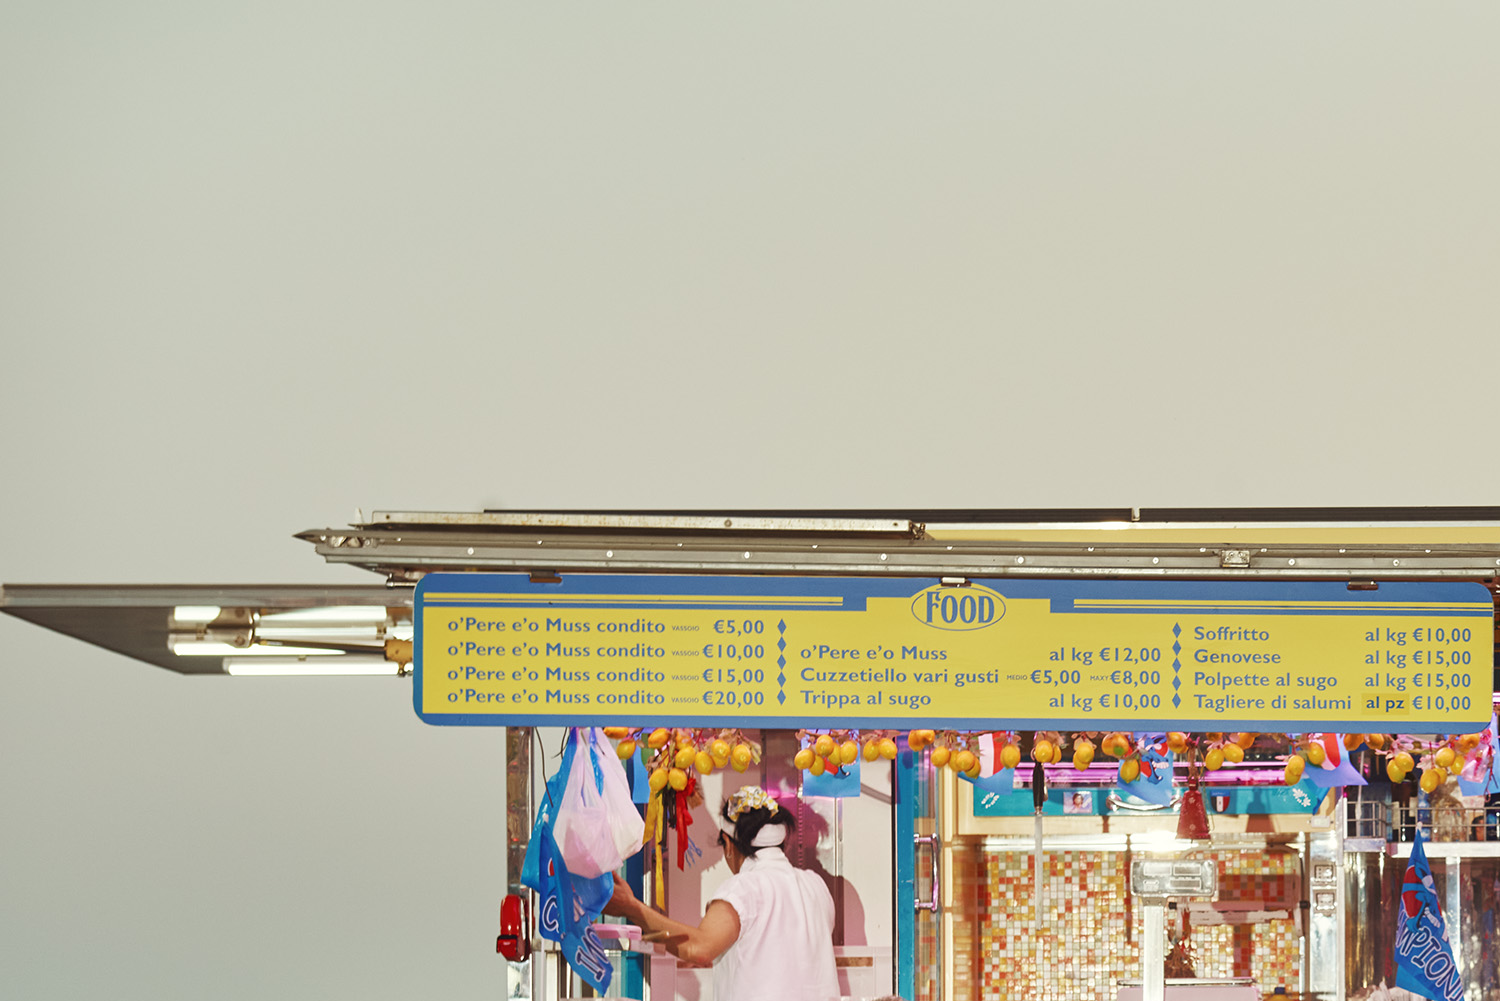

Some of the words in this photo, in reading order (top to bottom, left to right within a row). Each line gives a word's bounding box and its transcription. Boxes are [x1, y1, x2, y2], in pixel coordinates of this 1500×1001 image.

[926, 591, 996, 624] FOOD
[447, 616, 506, 632] o'Pere
[511, 617, 540, 632] e'o
[546, 617, 591, 633] Muss
[596, 618, 666, 633] condito
[713, 619, 765, 637] €5,00
[1194, 626, 1270, 641] Soffritto
[1365, 627, 1380, 642] al
[1386, 627, 1407, 647] kg
[1412, 627, 1472, 645] €10,00
[447, 641, 506, 656] o'Pere
[511, 642, 539, 657] e'o
[545, 642, 591, 657] Muss
[596, 643, 666, 658] condito
[671, 649, 700, 657] VASSOIO
[702, 643, 765, 661] €10,00
[800, 644, 860, 660] o'Pere
[866, 645, 895, 660] e'o
[901, 645, 948, 661] Muss
[1049, 647, 1065, 662] al
[1071, 647, 1093, 666] kg
[1099, 647, 1161, 665] €12,00
[1193, 648, 1281, 664] Genovese
[1364, 649, 1380, 665] al
[1386, 650, 1407, 669] kg
[1412, 650, 1472, 668] €15,00
[447, 666, 506, 681] o'Pere
[511, 666, 539, 681] e'o
[545, 666, 591, 682] Muss
[596, 667, 666, 682] condito
[702, 668, 765, 686] €15,00
[800, 667, 907, 683] Cuzzetiello
[913, 668, 948, 683] vari
[954, 669, 999, 688] gusti
[1030, 669, 1081, 687] €5,00
[1110, 670, 1161, 688] €8,00
[1194, 671, 1270, 691] Polpette
[1275, 672, 1291, 687] al
[1296, 676, 1338, 692] sugo
[1364, 672, 1380, 687] al
[1386, 672, 1407, 692] kg
[1412, 672, 1472, 690] €15,00
[447, 688, 506, 703] o'Pere
[511, 688, 539, 704] e'o
[545, 689, 591, 704] Muss
[596, 690, 666, 705] condito
[671, 696, 700, 704] VASSOIO
[702, 690, 765, 708] €20,00
[799, 690, 861, 709] Trippa
[866, 690, 882, 705] al
[888, 695, 932, 710] sugo
[1049, 693, 1065, 708] al
[1071, 693, 1093, 713] kg
[1099, 693, 1161, 711] €10,00
[1193, 694, 1265, 713] Tagliere
[1271, 695, 1287, 709] di
[1293, 695, 1351, 710] salumi
[1366, 695, 1380, 709] al
[1385, 699, 1405, 713] pz
[1412, 695, 1471, 713] €10,00
